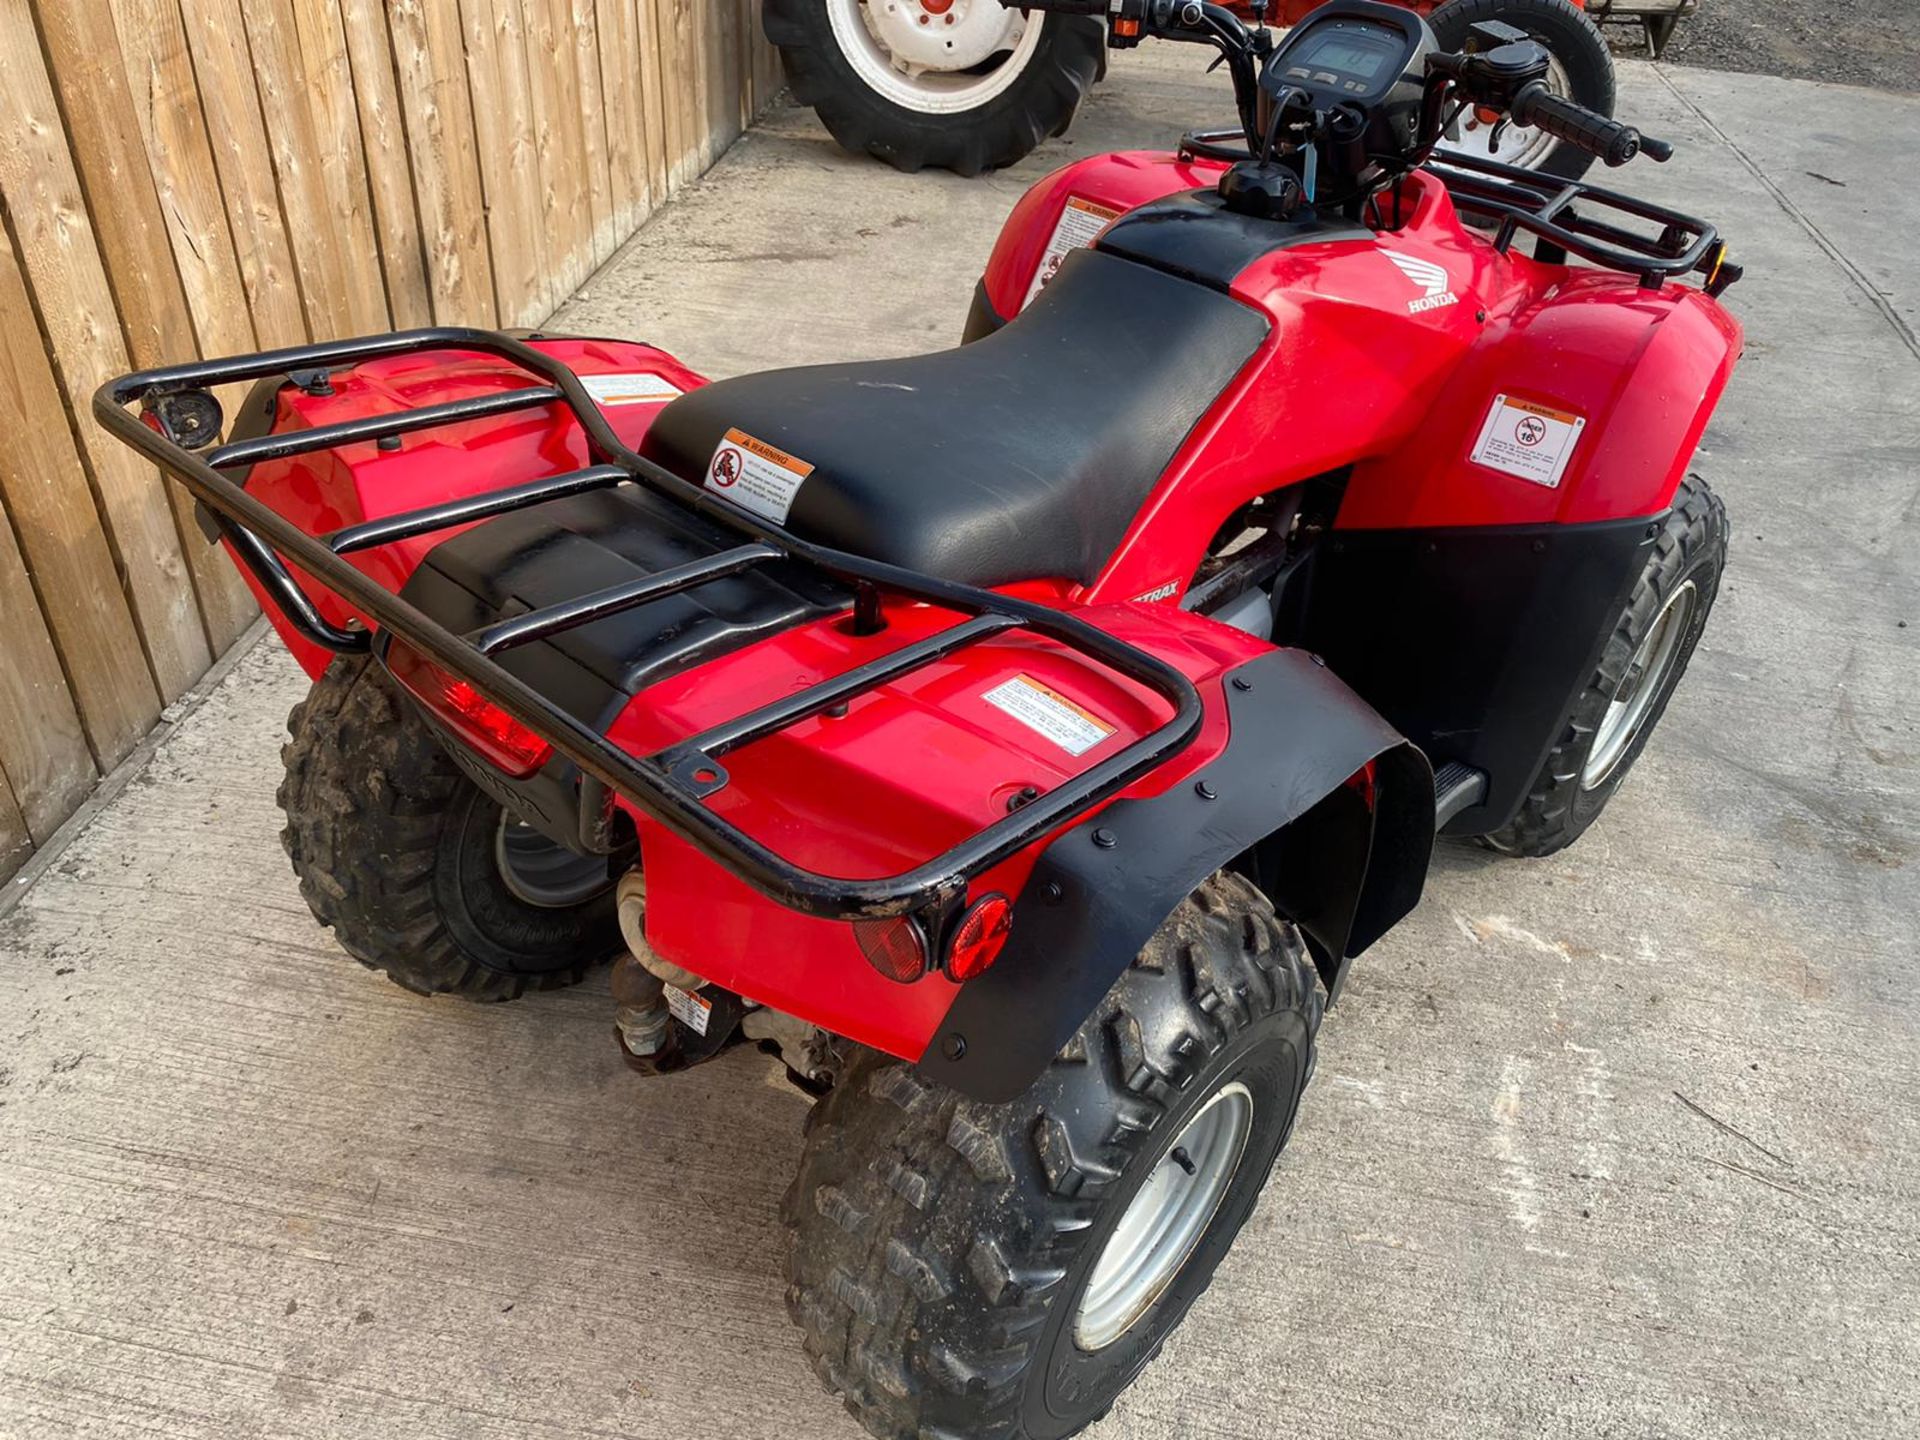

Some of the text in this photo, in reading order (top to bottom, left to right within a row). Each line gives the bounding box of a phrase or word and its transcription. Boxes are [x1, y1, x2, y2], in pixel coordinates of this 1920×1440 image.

[1407, 292, 1459, 314] HONDA
[1521, 432, 1534, 443] 16
[751, 442, 789, 465] WARNING
